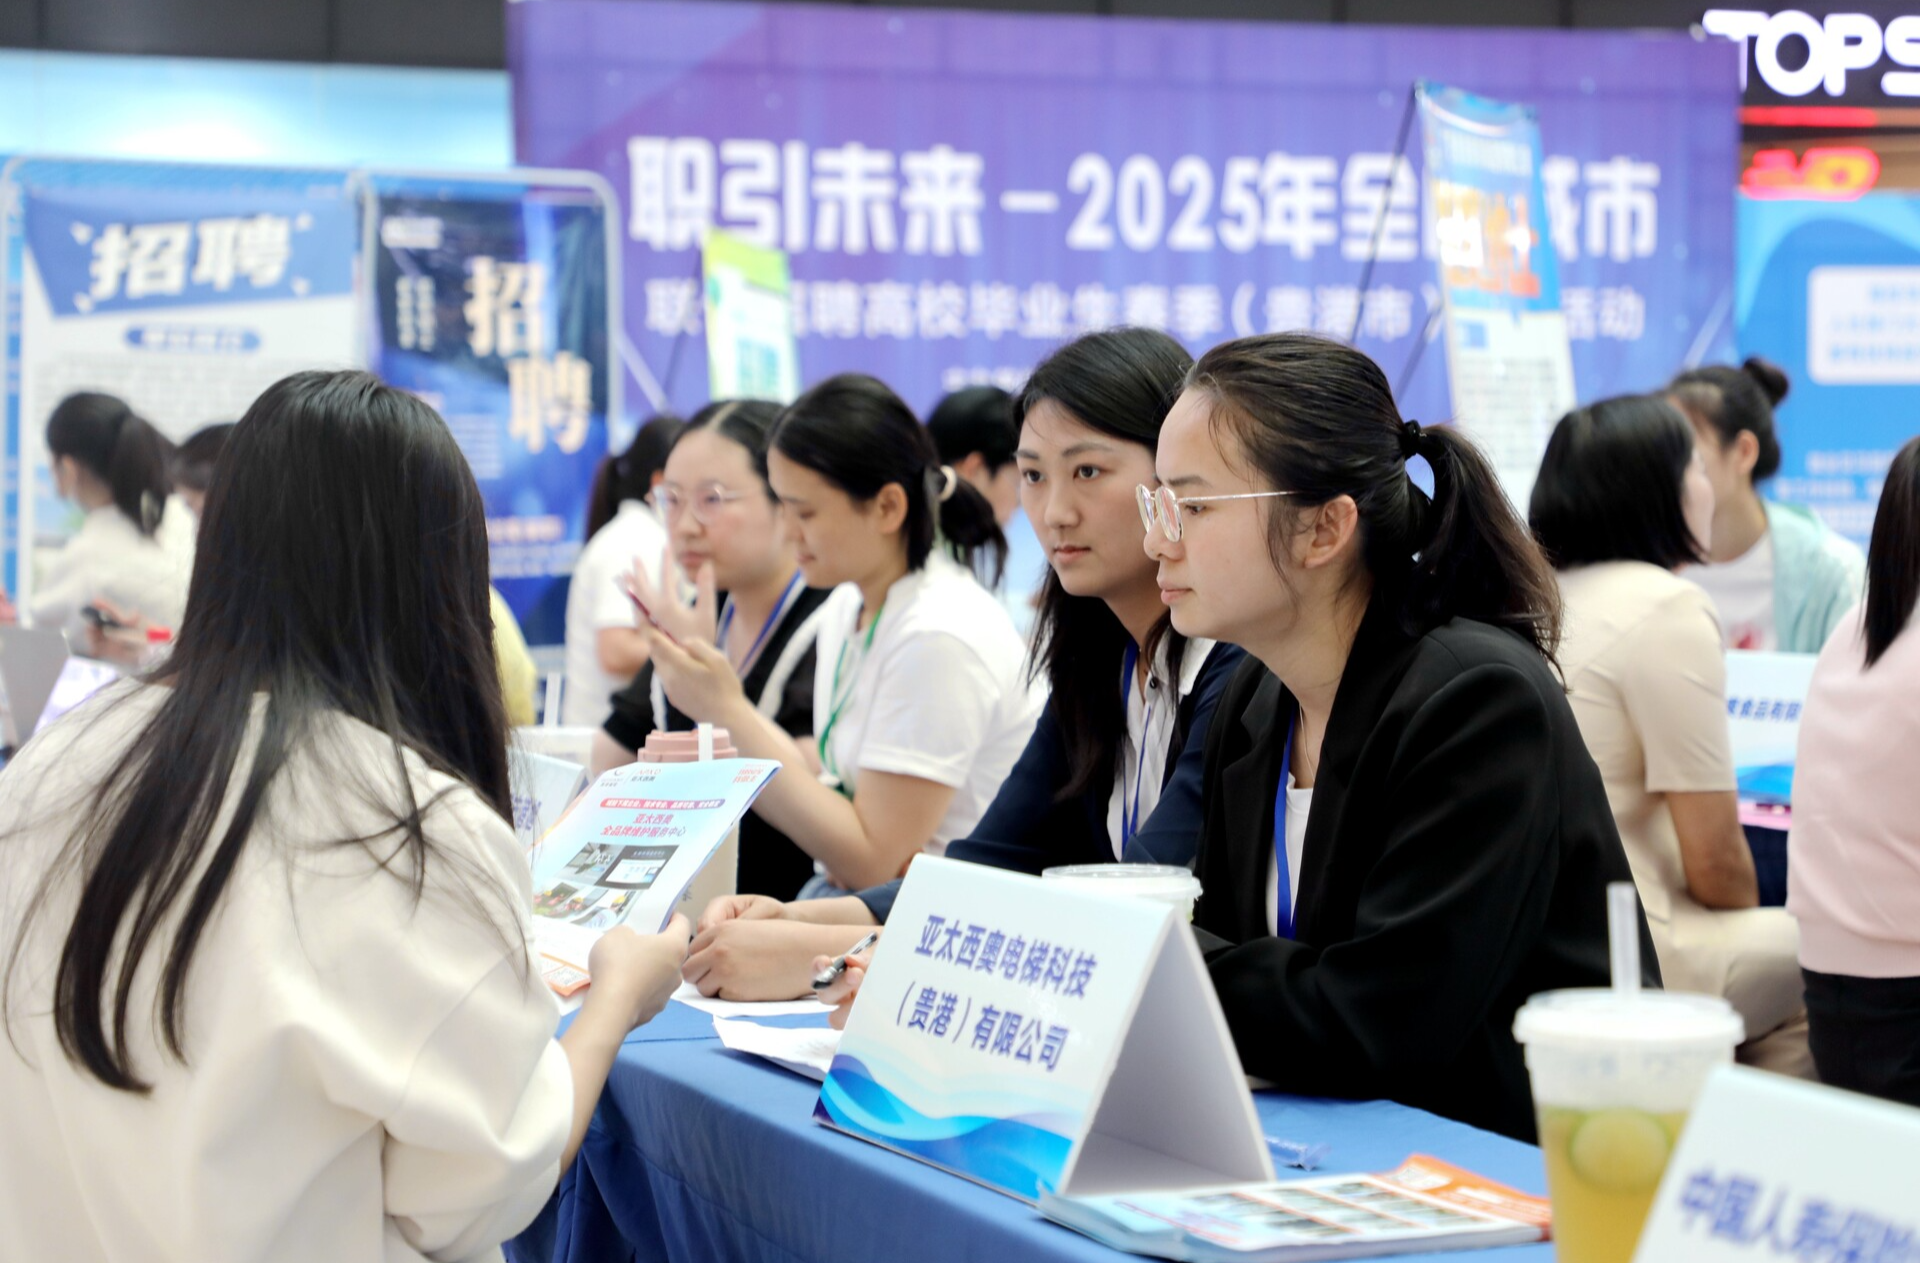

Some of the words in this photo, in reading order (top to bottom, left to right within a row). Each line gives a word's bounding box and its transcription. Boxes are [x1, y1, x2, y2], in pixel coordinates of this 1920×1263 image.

[92, 214, 291, 301] 招聘
[462, 256, 593, 453] 招聘
[914, 914, 1098, 998] 亚太西奥电梯科技
[897, 981, 1071, 1073] （贵港）有限公司
